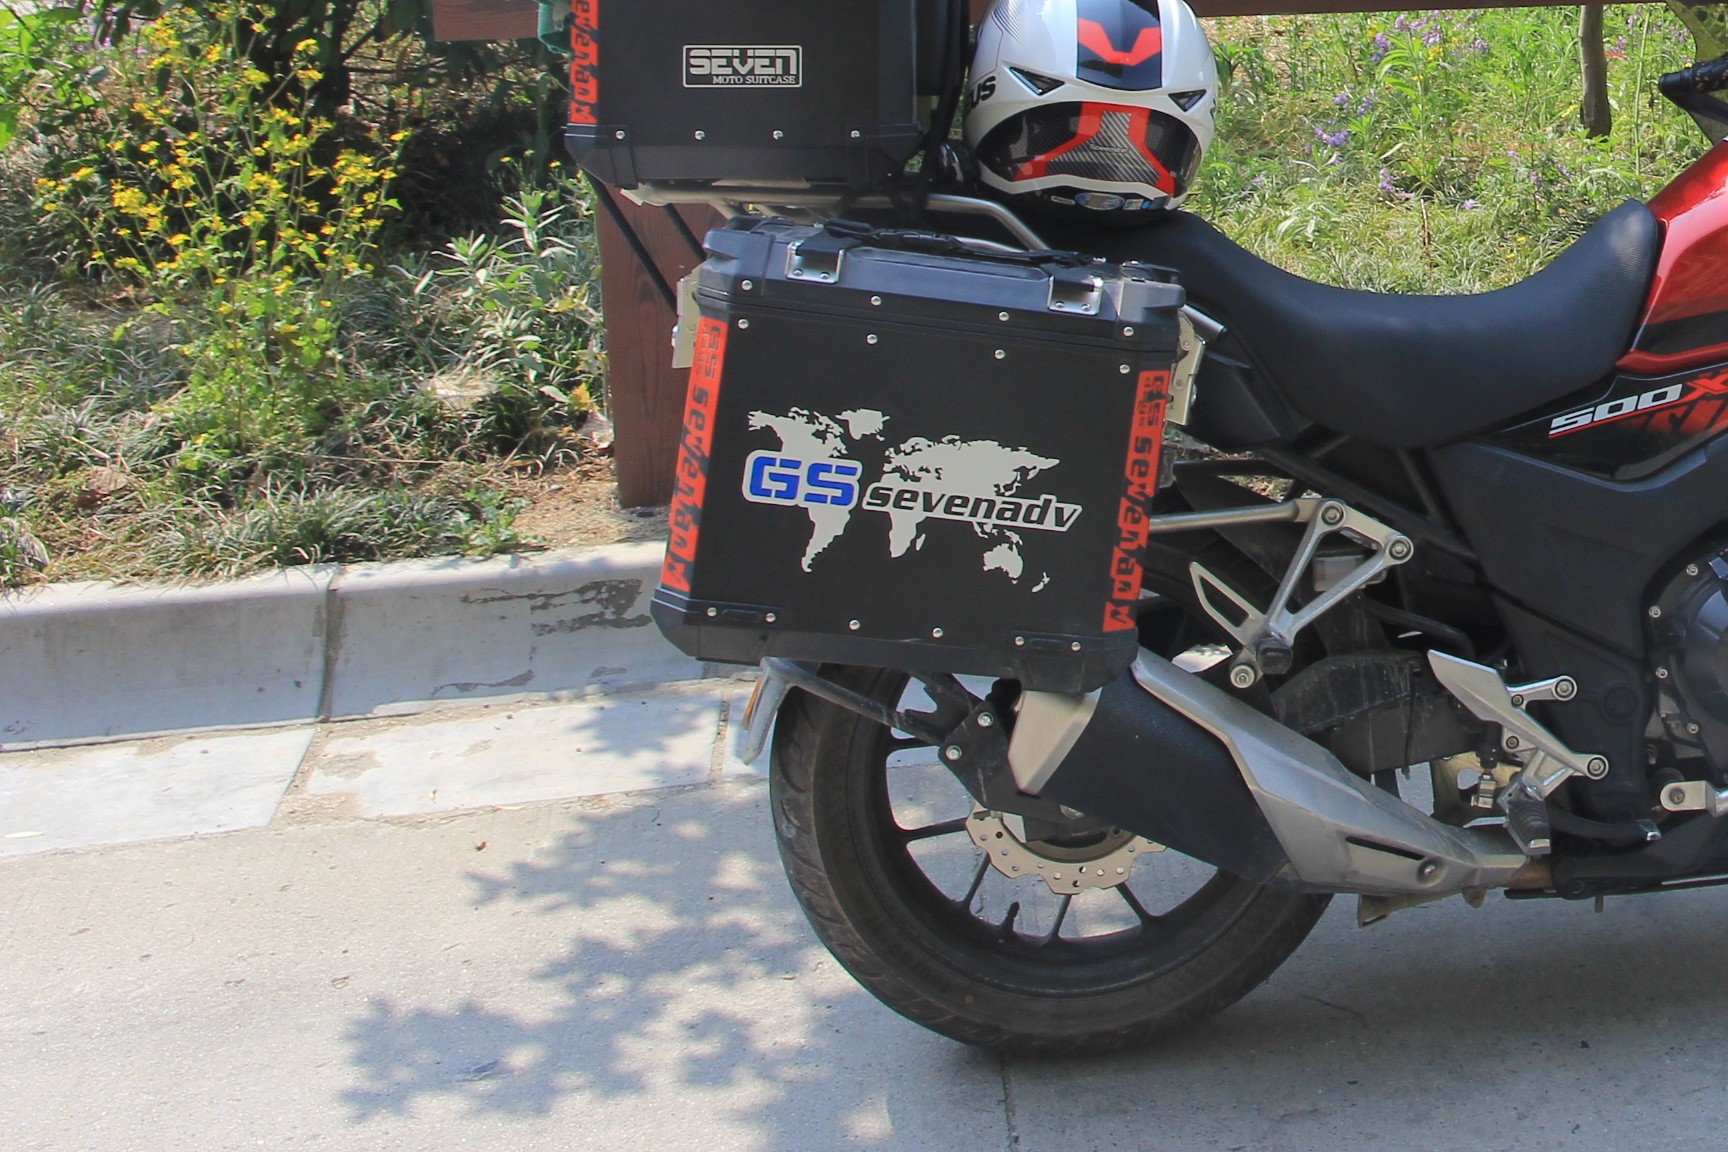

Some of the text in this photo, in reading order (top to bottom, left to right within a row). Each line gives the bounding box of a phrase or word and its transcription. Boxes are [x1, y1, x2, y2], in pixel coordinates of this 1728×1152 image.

[689, 49, 797, 75] SEVEN
[712, 74, 796, 84] MOTO SUITCASE
[749, 454, 1079, 530] GS sevenadv
